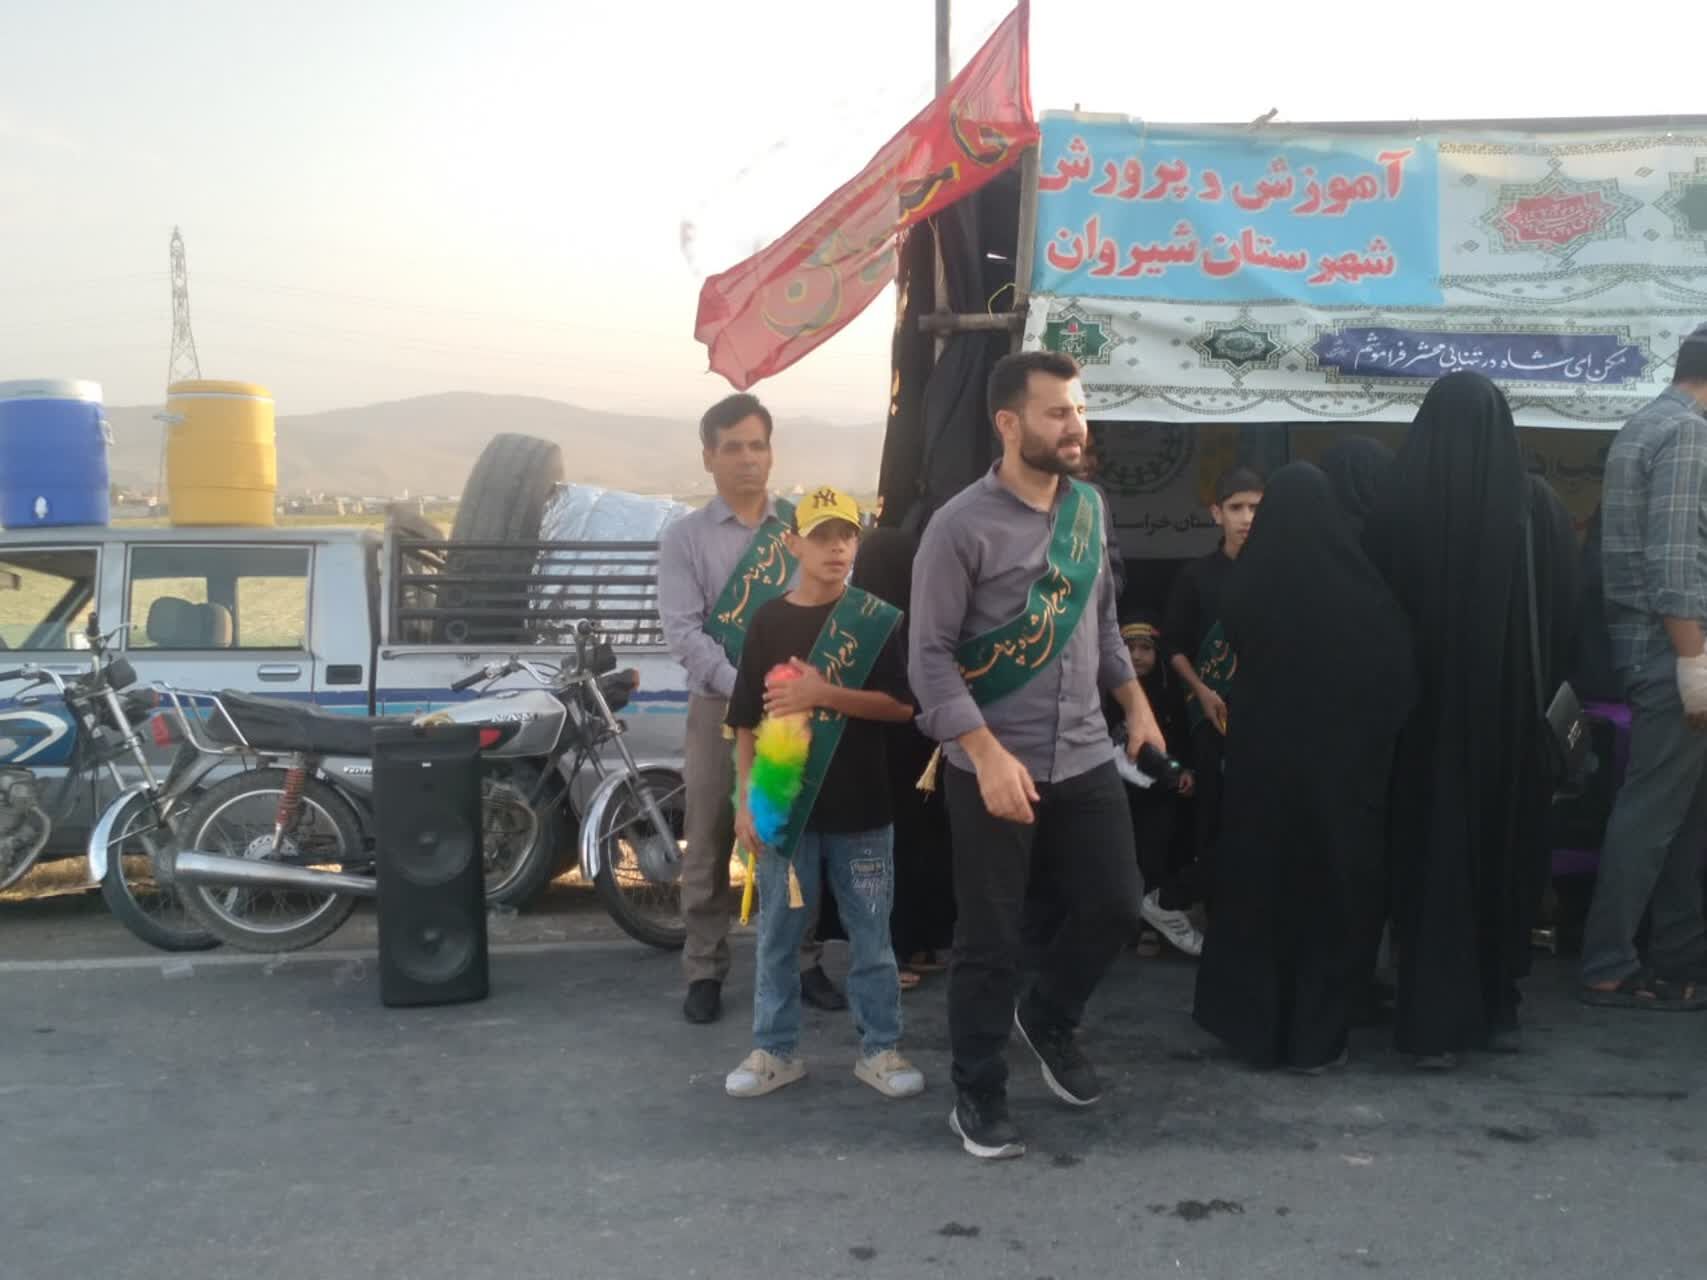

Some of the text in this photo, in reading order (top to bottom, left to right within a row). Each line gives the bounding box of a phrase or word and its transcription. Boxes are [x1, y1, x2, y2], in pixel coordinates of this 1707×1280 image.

[1039, 137, 1191, 201] پرورش
[1232, 149, 1413, 214] آموزش
[1047, 215, 1395, 284] شهرستان شیروان
[1500, 346, 1574, 370] شاه
[1585, 346, 1628, 382] مکن
[812, 489, 838, 509] NY
